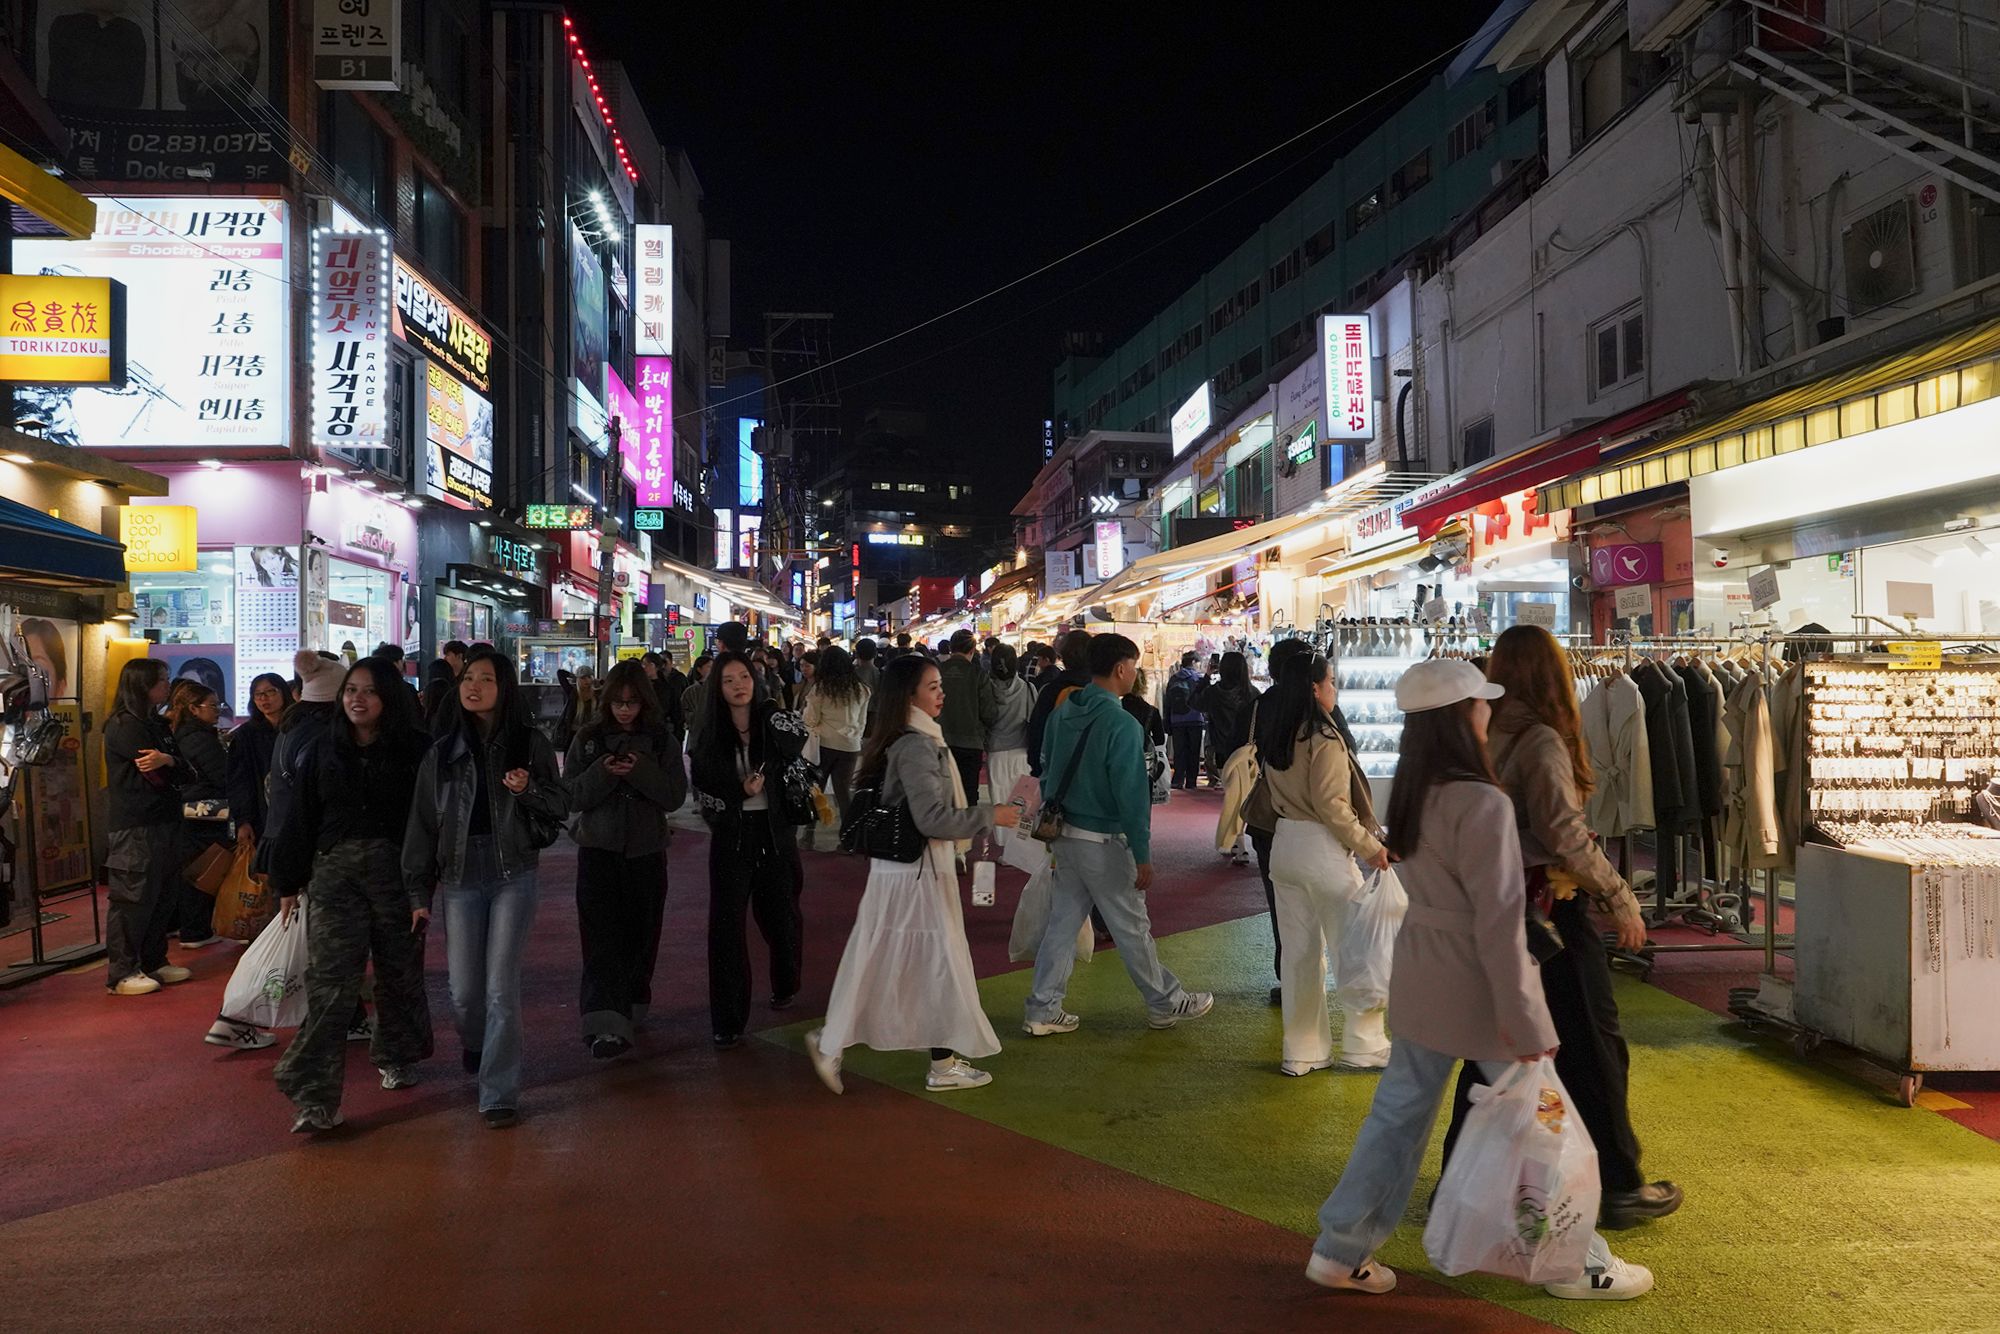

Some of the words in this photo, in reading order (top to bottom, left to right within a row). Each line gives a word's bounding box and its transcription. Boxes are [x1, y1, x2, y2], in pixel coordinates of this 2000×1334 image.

[320, 24, 387, 47] 프렌즈
[340, 59, 367, 77] B1
[128, 132, 271, 154] 02.831.0375
[245, 165, 269, 179] 3F
[184, 212, 267, 237] 사격장
[1923, 208, 1937, 224] LG
[129, 245, 204, 258] Shooting
[208, 245, 262, 258] Range
[208, 269, 255, 292] 권총
[325, 238, 362, 333] 리얼샷
[643, 240, 664, 340] 힐링카페
[365, 251, 376, 341] SHOOTING
[208, 312, 254, 334] 소총
[396, 267, 448, 343] 리얼샷!
[449, 313, 490, 374] 사격장
[10, 340, 98, 354] TORIKIZOKU
[198, 355, 267, 377] 저격총
[446, 352, 470, 381] Shooting
[326, 341, 361, 436] 사격장
[366, 352, 376, 407] RANGE
[639, 365, 669, 390] 홍대
[1345, 324, 1365, 431] 베트남쌀국수
[197, 398, 266, 421] 연사총
[359, 422, 380, 436] 2F
[648, 492, 660, 502] 2F
[129, 513, 154, 525] too
[129, 524, 161, 536] cool
[130, 538, 149, 550] for
[129, 549, 180, 563] school
[1620, 594, 1645, 610] SALE
